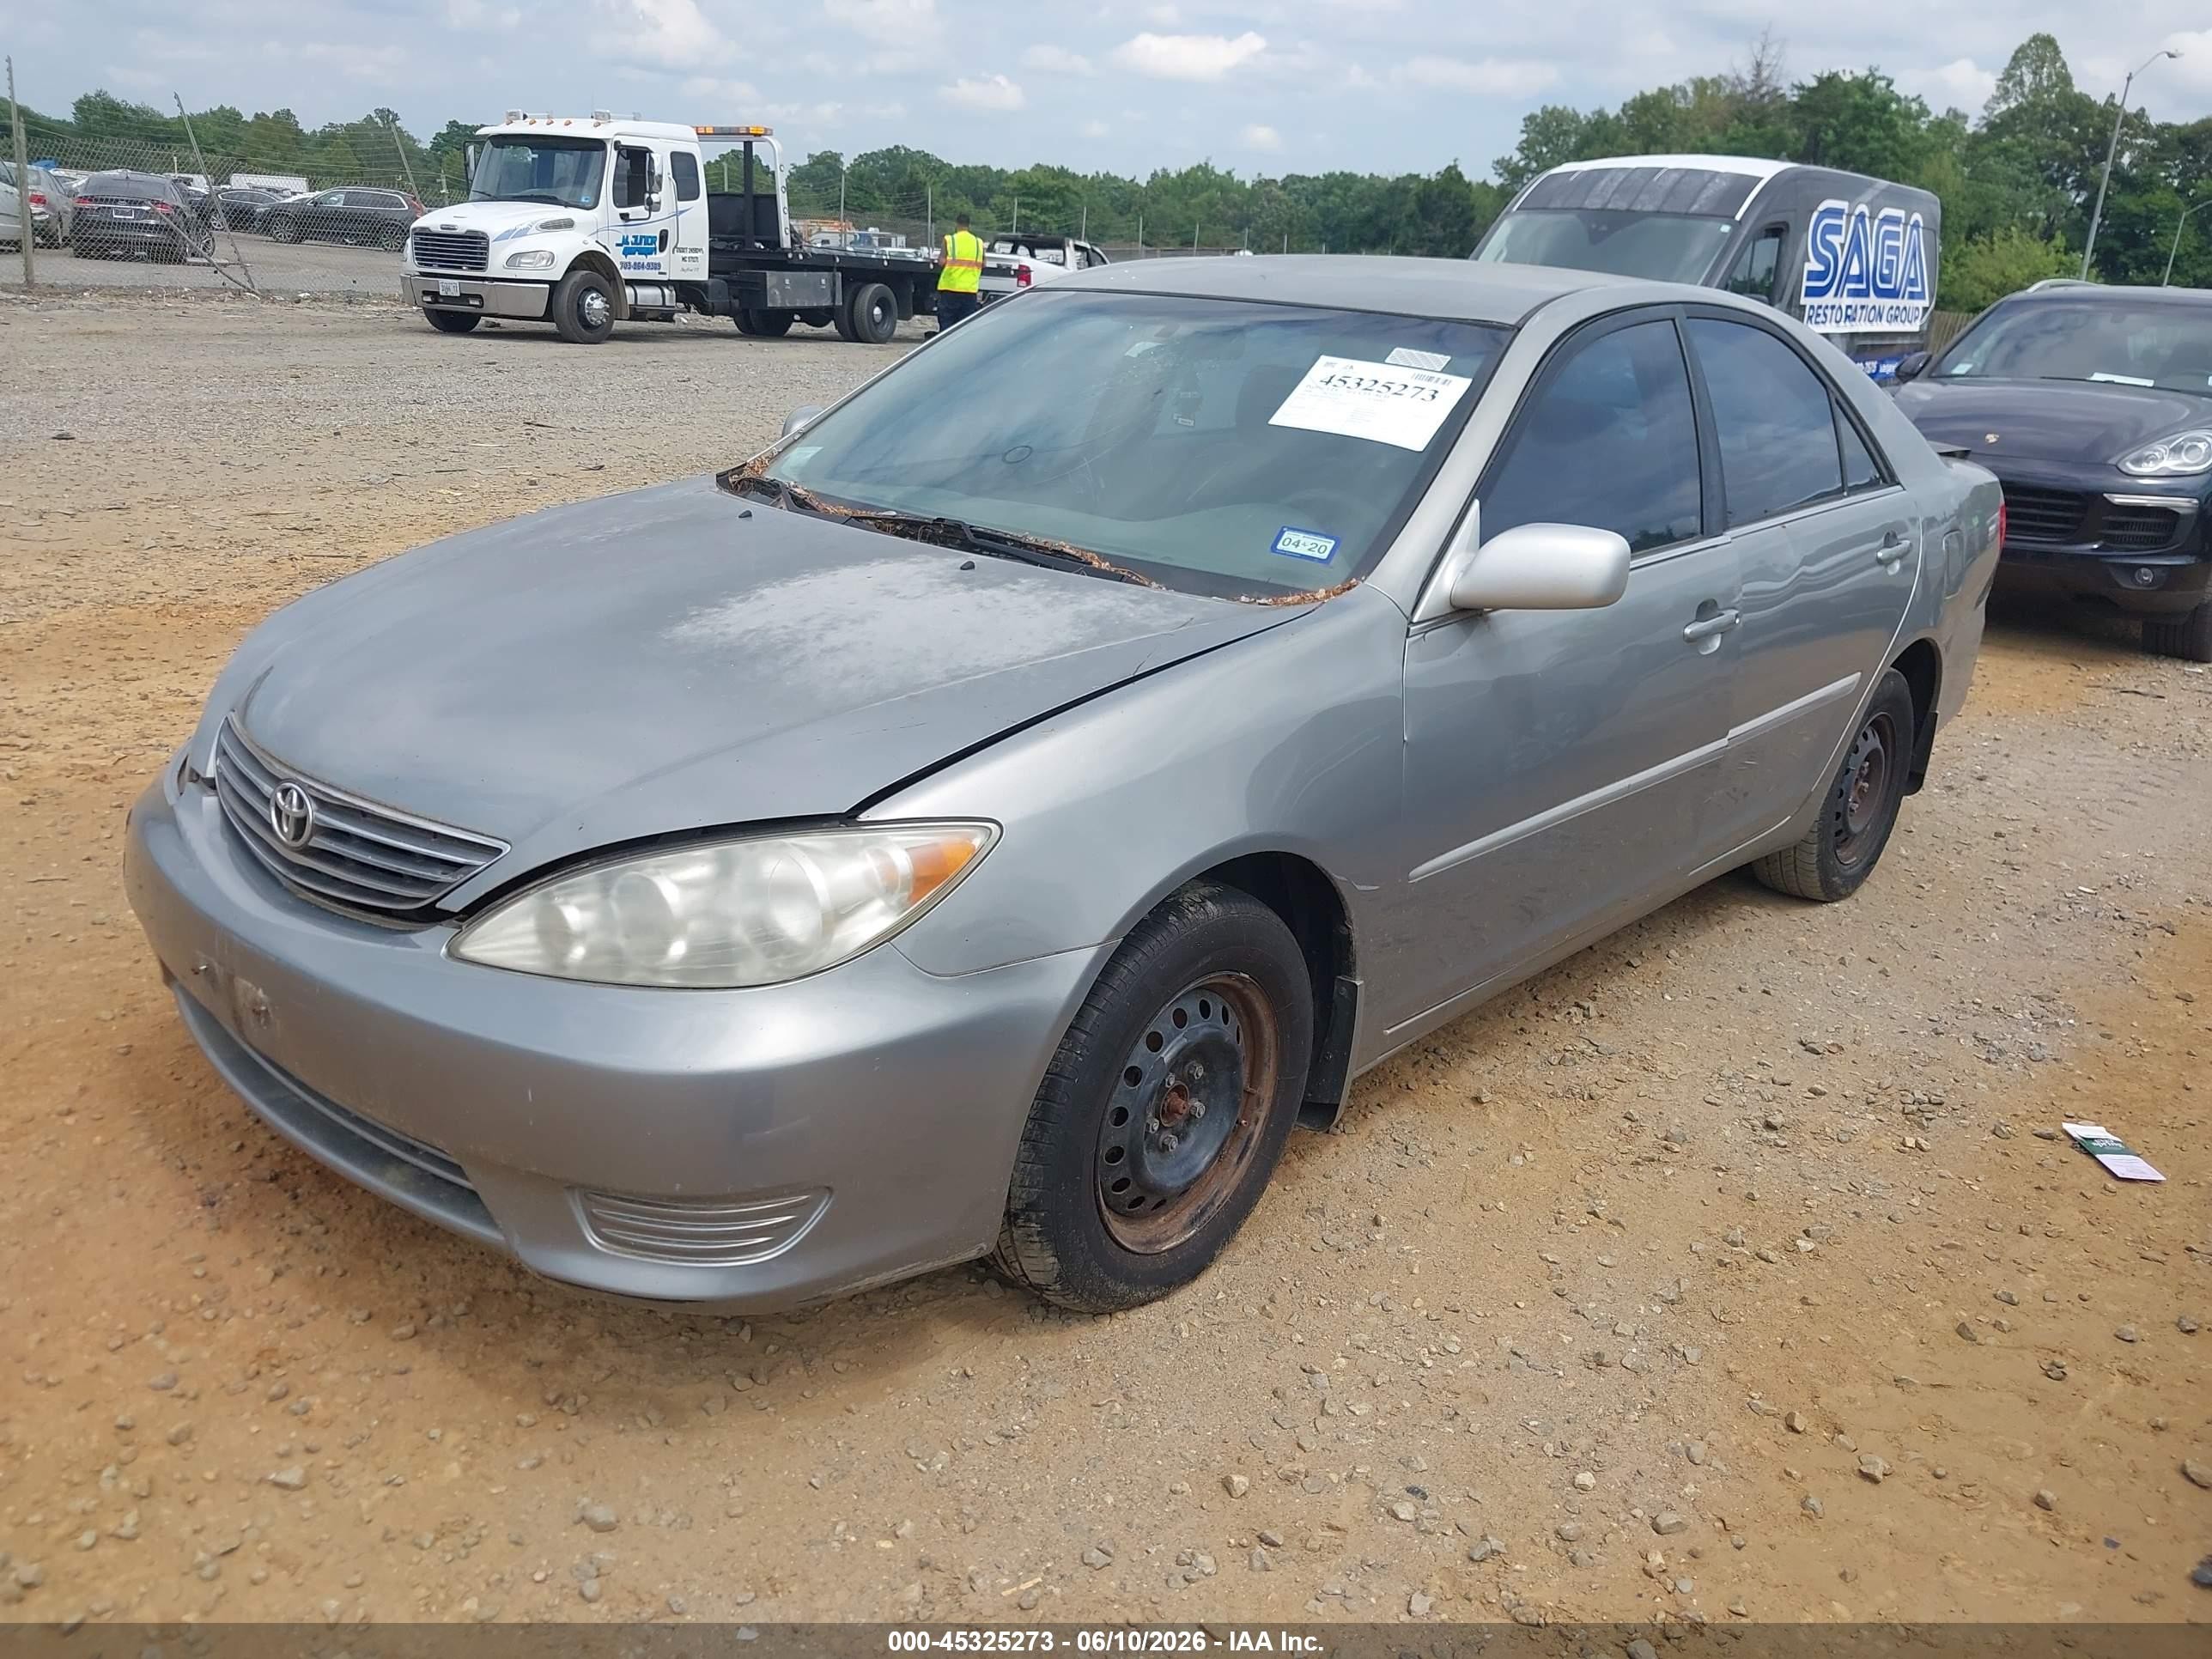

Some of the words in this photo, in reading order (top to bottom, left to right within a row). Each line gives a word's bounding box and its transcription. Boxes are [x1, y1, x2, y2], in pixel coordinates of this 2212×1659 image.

[1802, 201, 1928, 301] SAGA
[1806, 305, 1885, 325] RESTORATION
[1887, 305, 1920, 324] GROUP
[1320, 374, 1439, 402] 45325273
[1281, 537, 1301, 549] 04
[1308, 542, 1328, 555] 20
